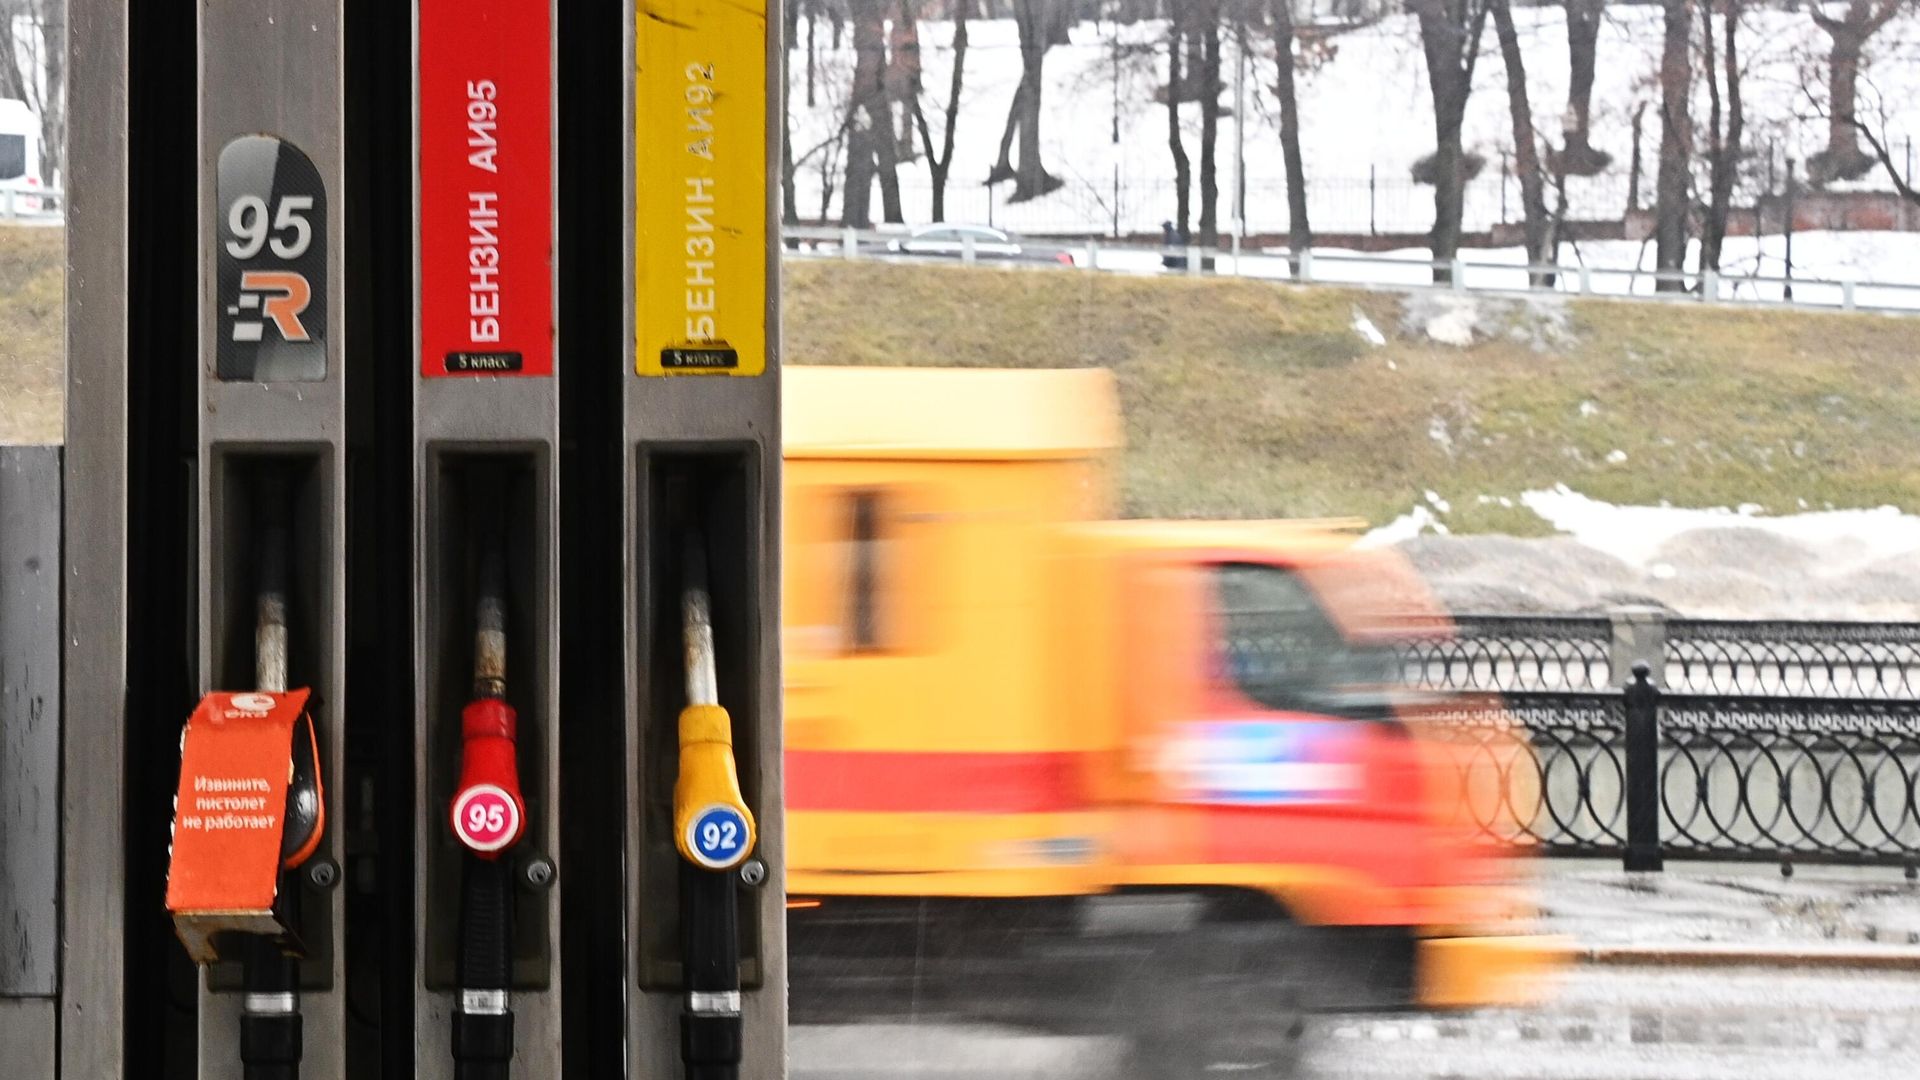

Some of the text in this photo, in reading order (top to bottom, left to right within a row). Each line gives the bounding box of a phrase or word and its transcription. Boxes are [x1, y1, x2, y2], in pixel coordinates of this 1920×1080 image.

[467, 80, 500, 343] БЕНЗИН АИ95
[686, 62, 715, 342] БЕНЗИН АИ92
[226, 195, 313, 260] 95
[459, 353, 468, 369] 5
[673, 350, 683, 366] 5
[194, 776, 271, 793] Извините,
[195, 797, 266, 811] пистолет
[183, 813, 275, 833] не работает
[468, 803, 505, 833] 95
[702, 820, 738, 851] 92
